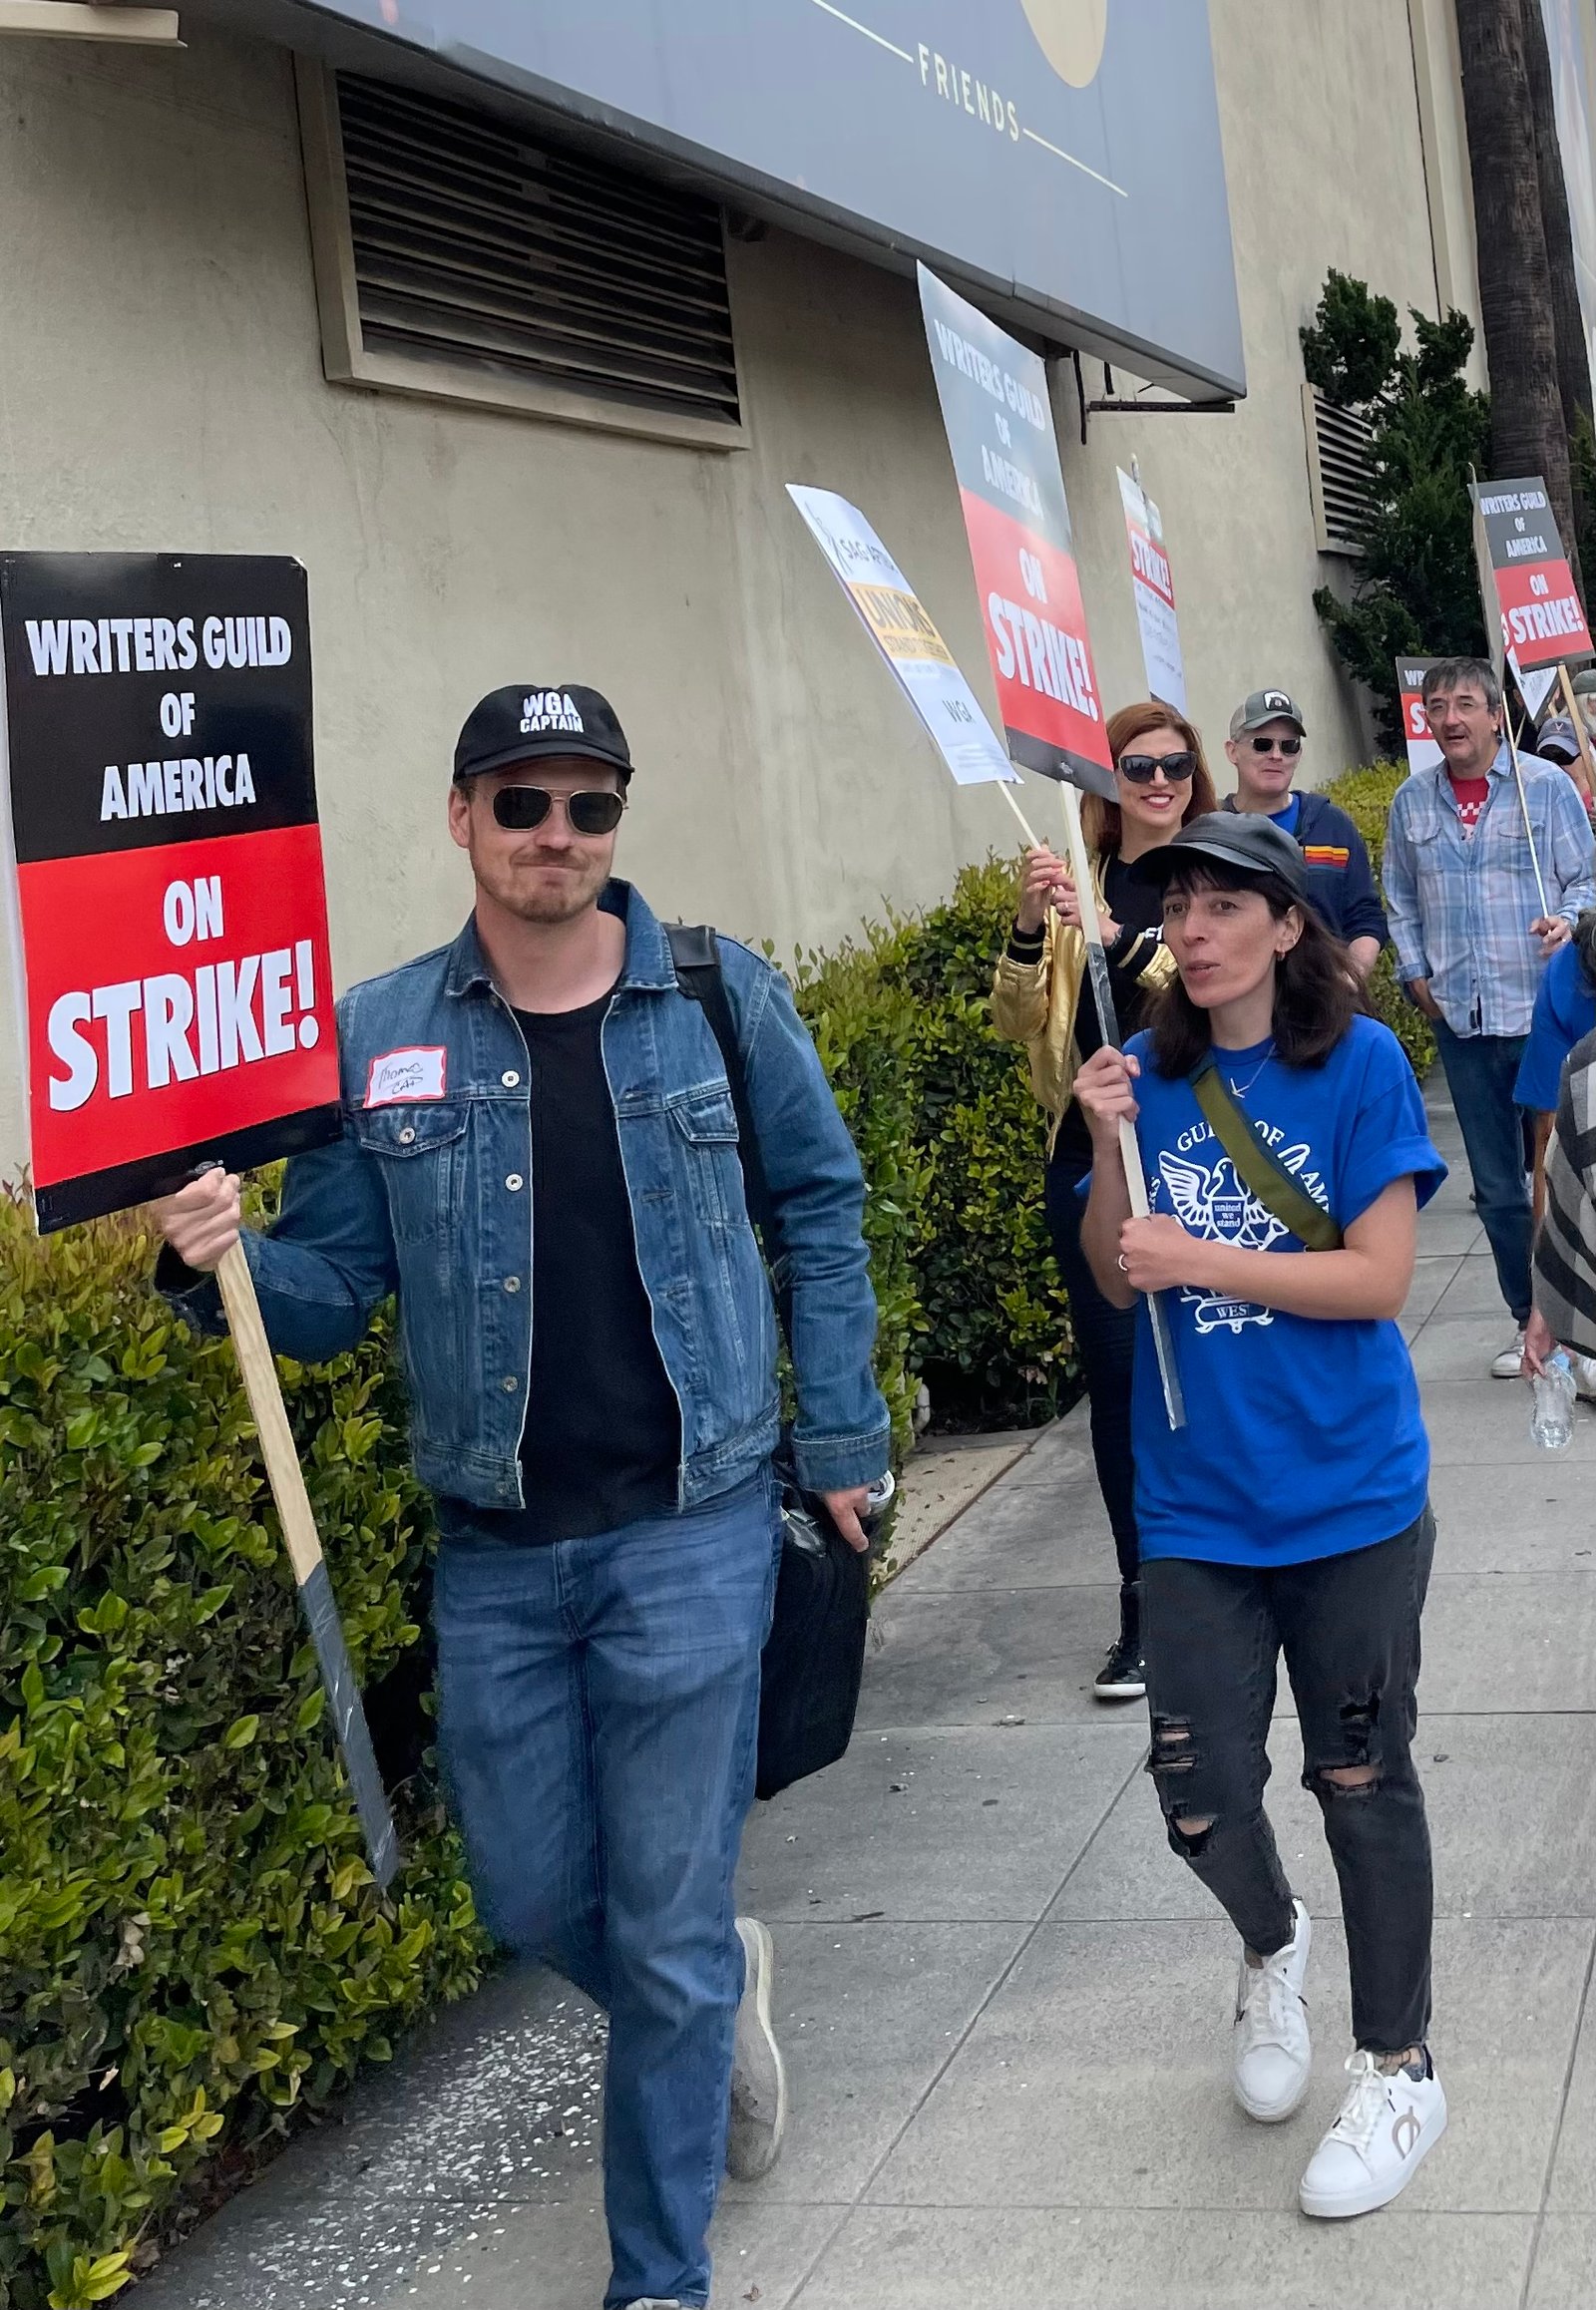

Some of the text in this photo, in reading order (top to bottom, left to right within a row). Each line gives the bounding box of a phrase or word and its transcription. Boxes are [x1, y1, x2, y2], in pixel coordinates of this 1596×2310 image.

[918, 42, 1020, 142] FRIENDS
[934, 318, 1045, 431] WRITERS GUILD
[982, 444, 1045, 521] AMERICA
[1480, 491, 1546, 516] WRITERS GUILD
[1505, 535, 1547, 558] AMERICA
[1514, 517, 1525, 532] OF
[1018, 548, 1047, 603] ON
[1529, 574, 1549, 596] ON
[1508, 595, 1584, 644] STRIKE!
[25, 615, 292, 676] WRITERS GUILD
[989, 591, 1098, 722] STRIKE!
[160, 692, 196, 737] OF
[520, 715, 585, 733] CAPTAIN
[523, 691, 582, 718] WGA
[100, 753, 256, 822] AMERICA
[163, 875, 224, 947] ON
[48, 939, 319, 1112] STRIKE!
[1177, 1121, 1216, 1152] GUI
[1214, 1202, 1241, 1212] united
[1216, 1217, 1240, 1227] stand
